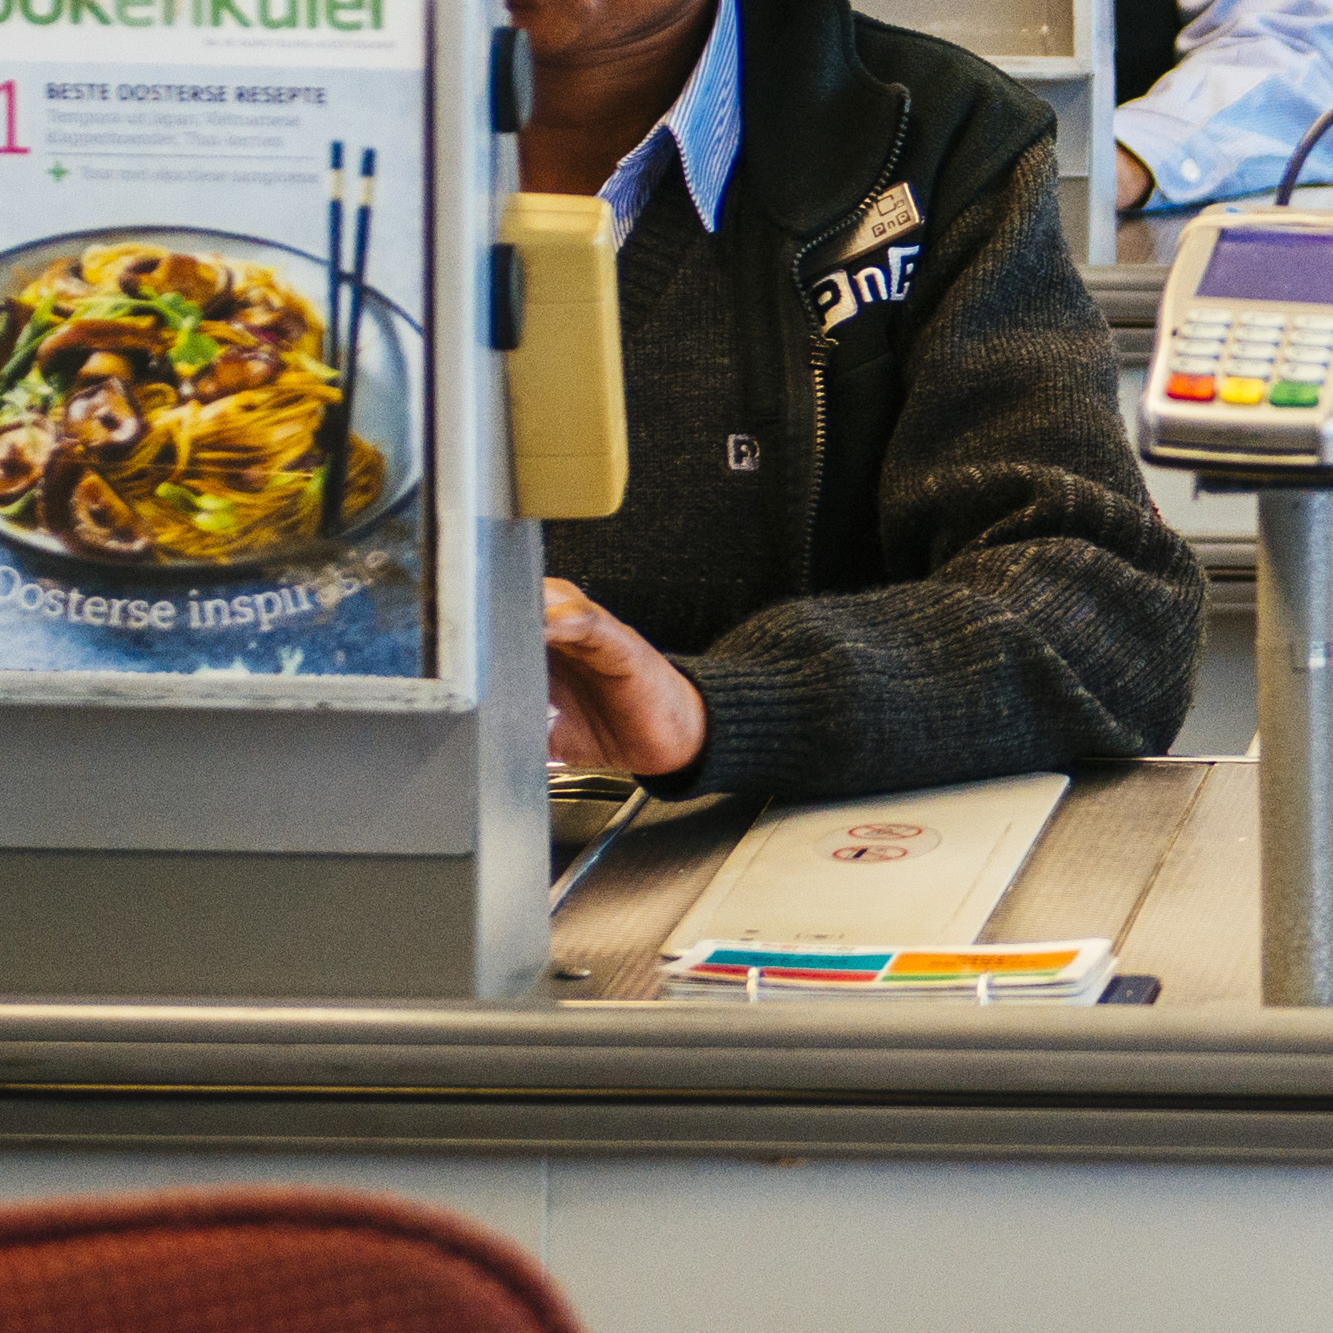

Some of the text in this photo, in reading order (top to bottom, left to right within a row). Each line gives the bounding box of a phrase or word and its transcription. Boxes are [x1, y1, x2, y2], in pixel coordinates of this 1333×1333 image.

[45, 82, 328, 105] BESTE OOSTERSE RESEPTE
[871, 209, 912, 238] PnP
[0, 566, 177, 631] Oosterse
